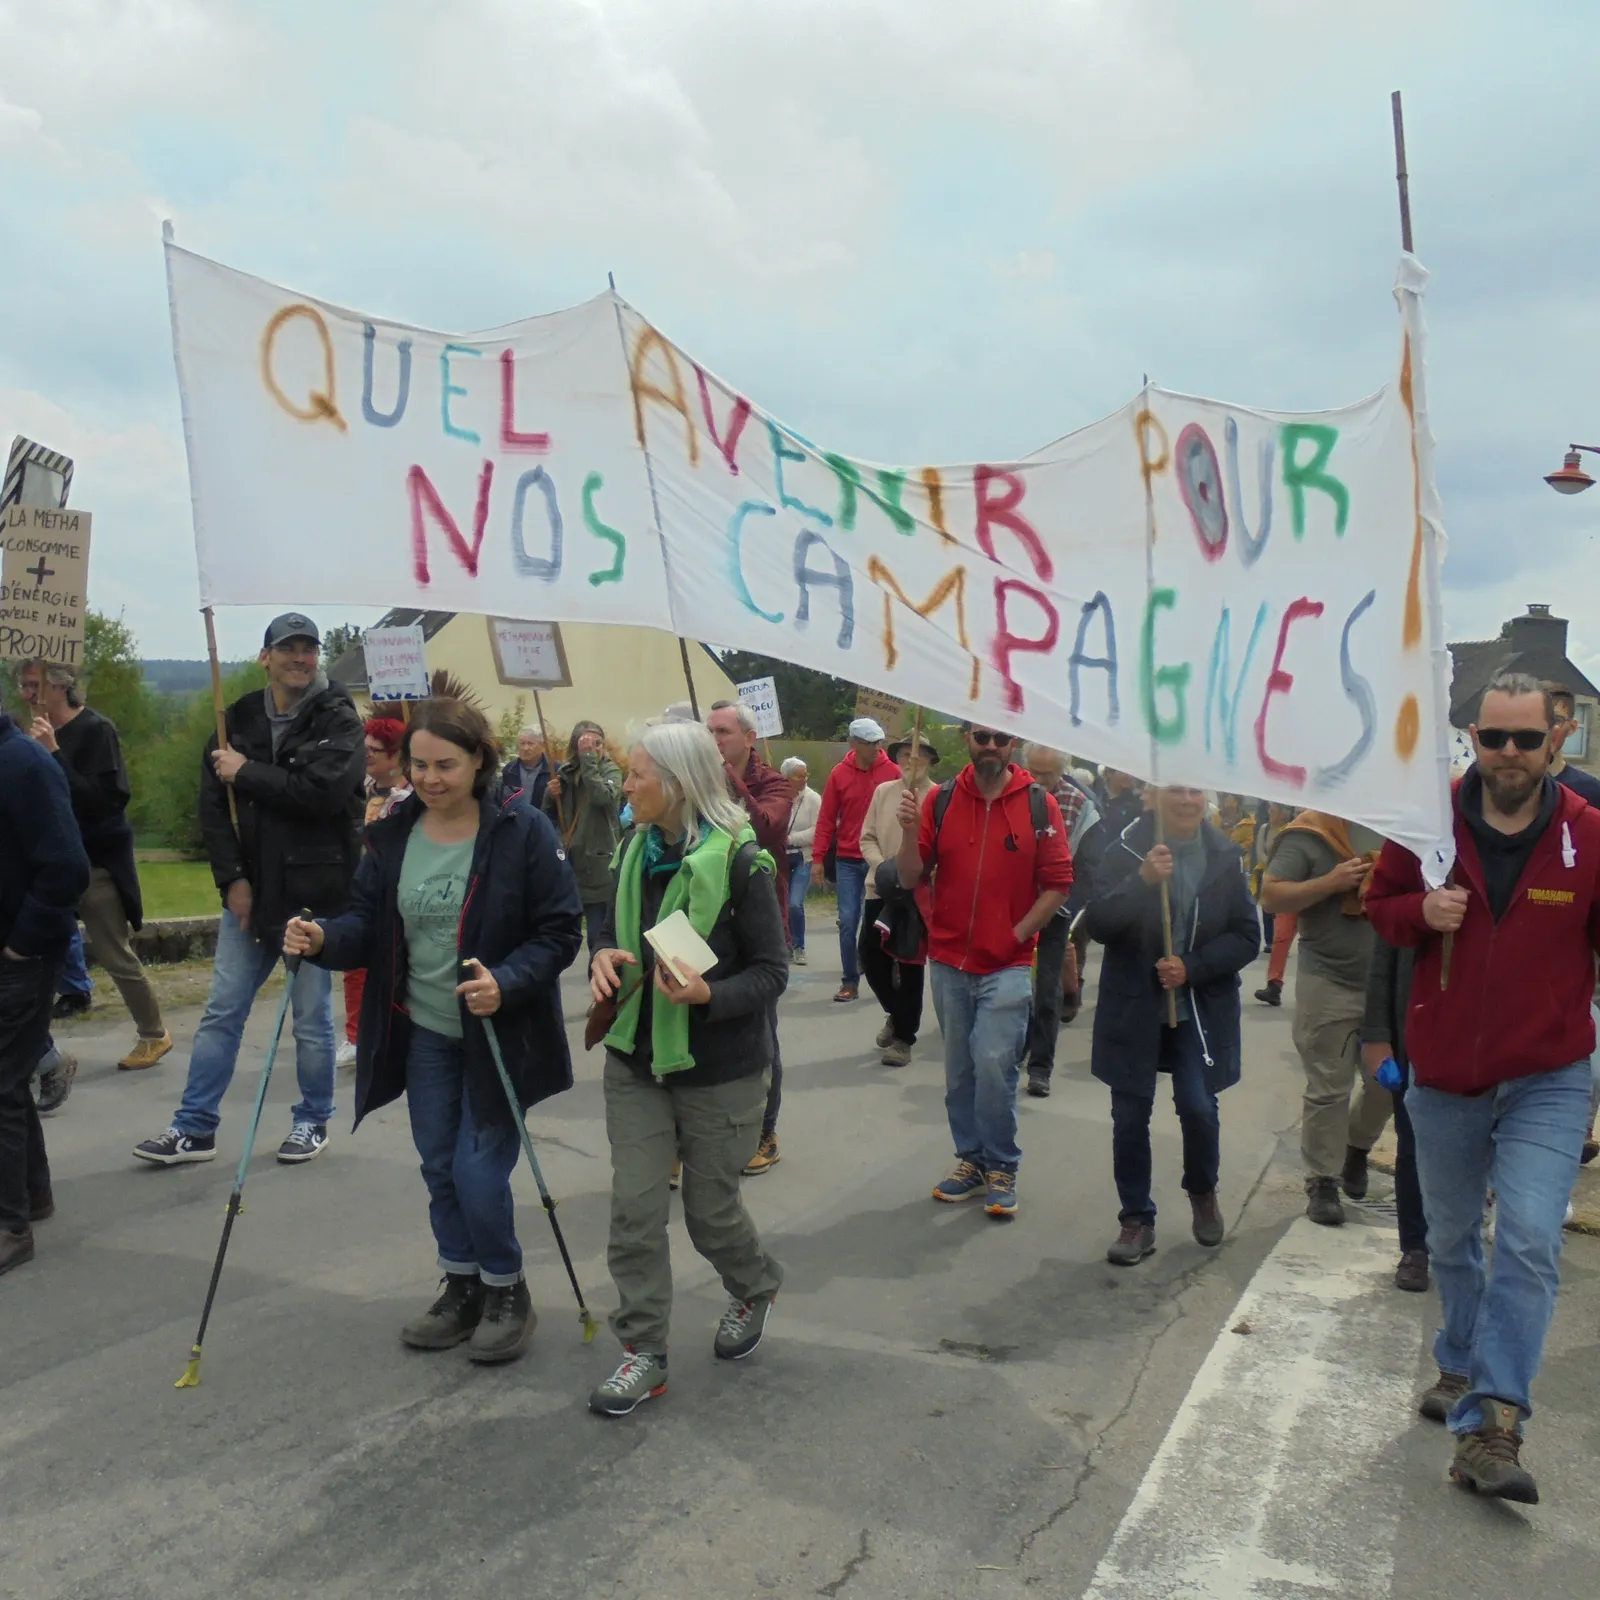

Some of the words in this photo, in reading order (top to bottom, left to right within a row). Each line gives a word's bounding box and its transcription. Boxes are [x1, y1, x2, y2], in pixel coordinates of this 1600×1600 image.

[261, 303, 550, 448] QUEL
[630, 323, 1053, 583] AVENIR
[1135, 409, 1349, 568] POUR
[9, 508, 26, 527] LA
[405, 459, 626, 586] NOS
[6, 537, 80, 559] CONSOMME
[47, 612, 76, 628] N'EN
[0, 625, 82, 663] PRODUIT
[751, 700, 774, 713] DIEU
[1527, 888, 1575, 904] TOMAHAWK
